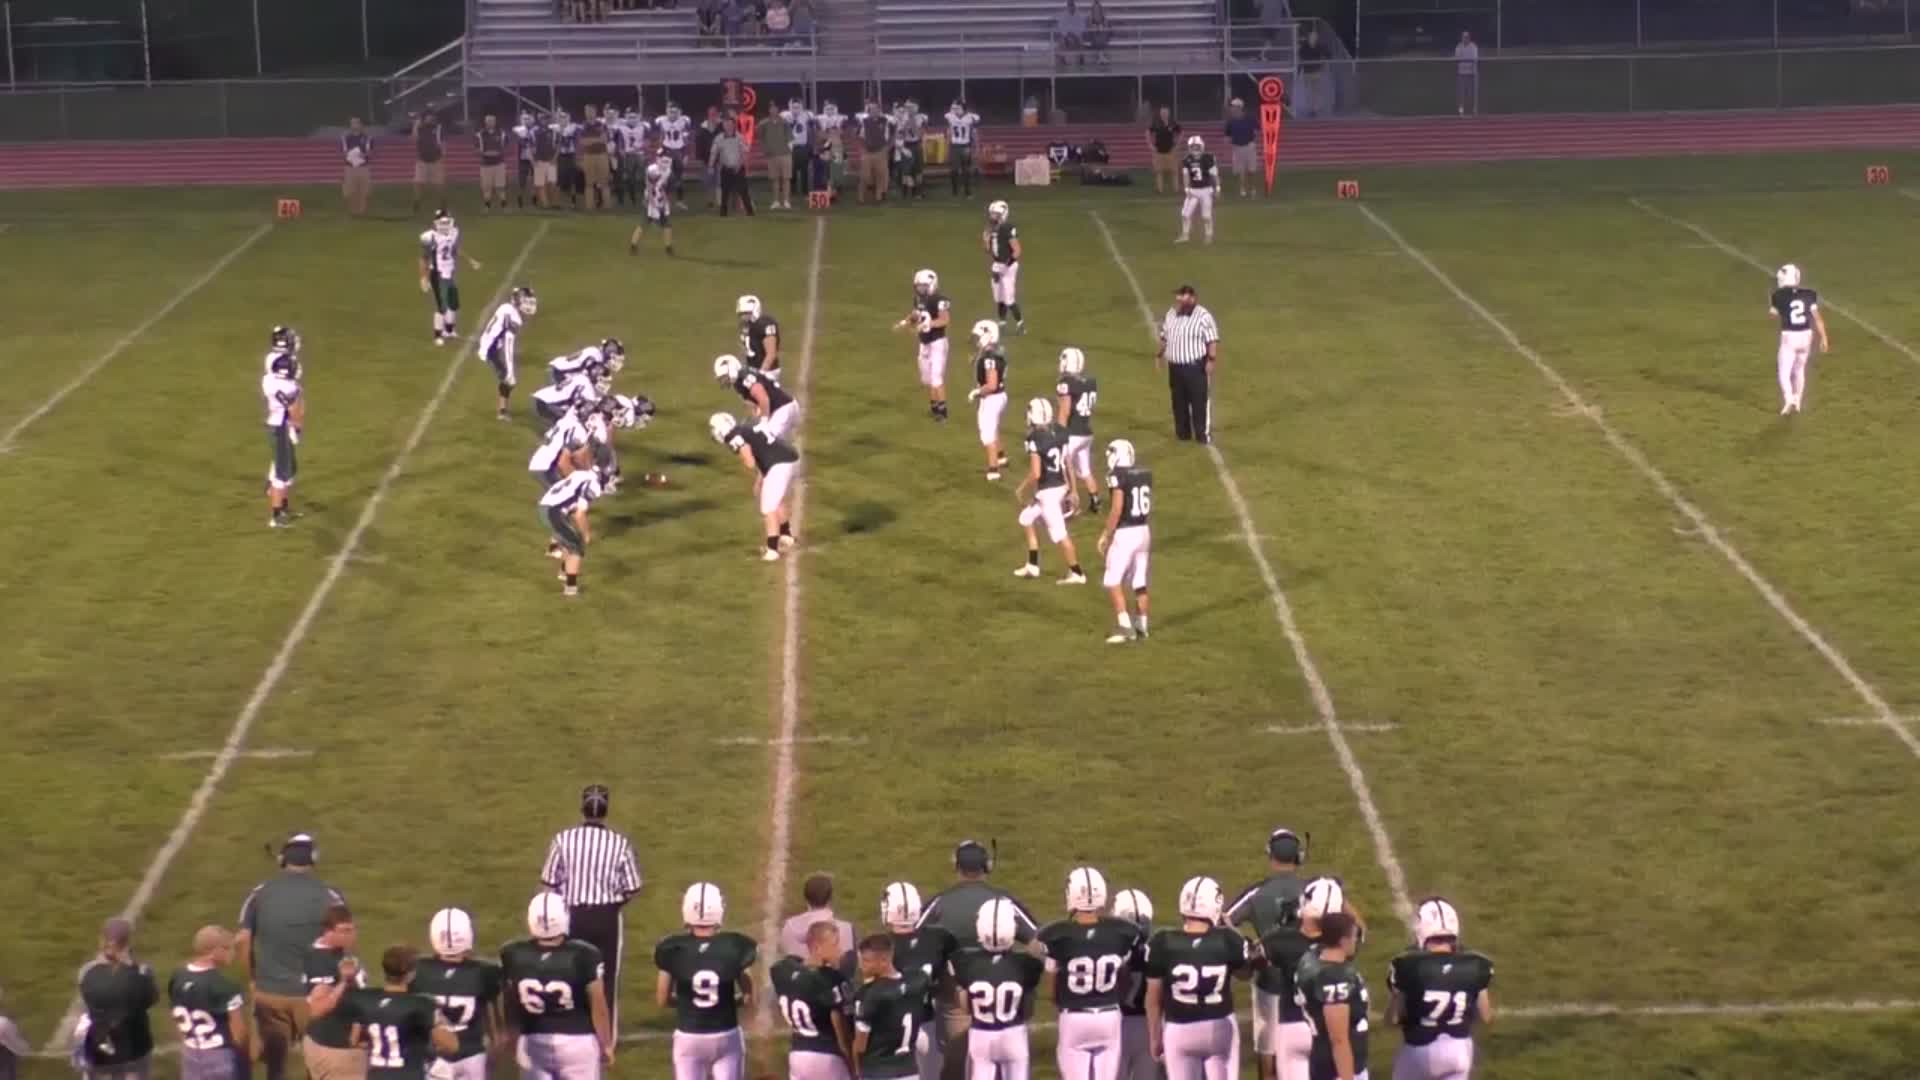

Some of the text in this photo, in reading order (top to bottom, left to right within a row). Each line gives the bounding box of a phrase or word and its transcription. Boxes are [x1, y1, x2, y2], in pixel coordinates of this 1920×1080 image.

[811, 192, 828, 208] 50
[1340, 183, 1357, 197] 40
[280, 202, 298, 217] 40
[1790, 300, 1806, 324] 2
[1131, 485, 1150, 516] 16
[692, 970, 720, 1008] 9
[1067, 954, 1122, 995] 80
[1170, 965, 1229, 1005] 27
[1323, 982, 1349, 1002] 75
[779, 995, 819, 1036] 10
[968, 980, 1023, 1023] 20
[1420, 990, 1467, 1027] 71
[172, 1005, 223, 1049] 22
[368, 1023, 405, 1067] 11
[894, 1013, 913, 1054] 1
